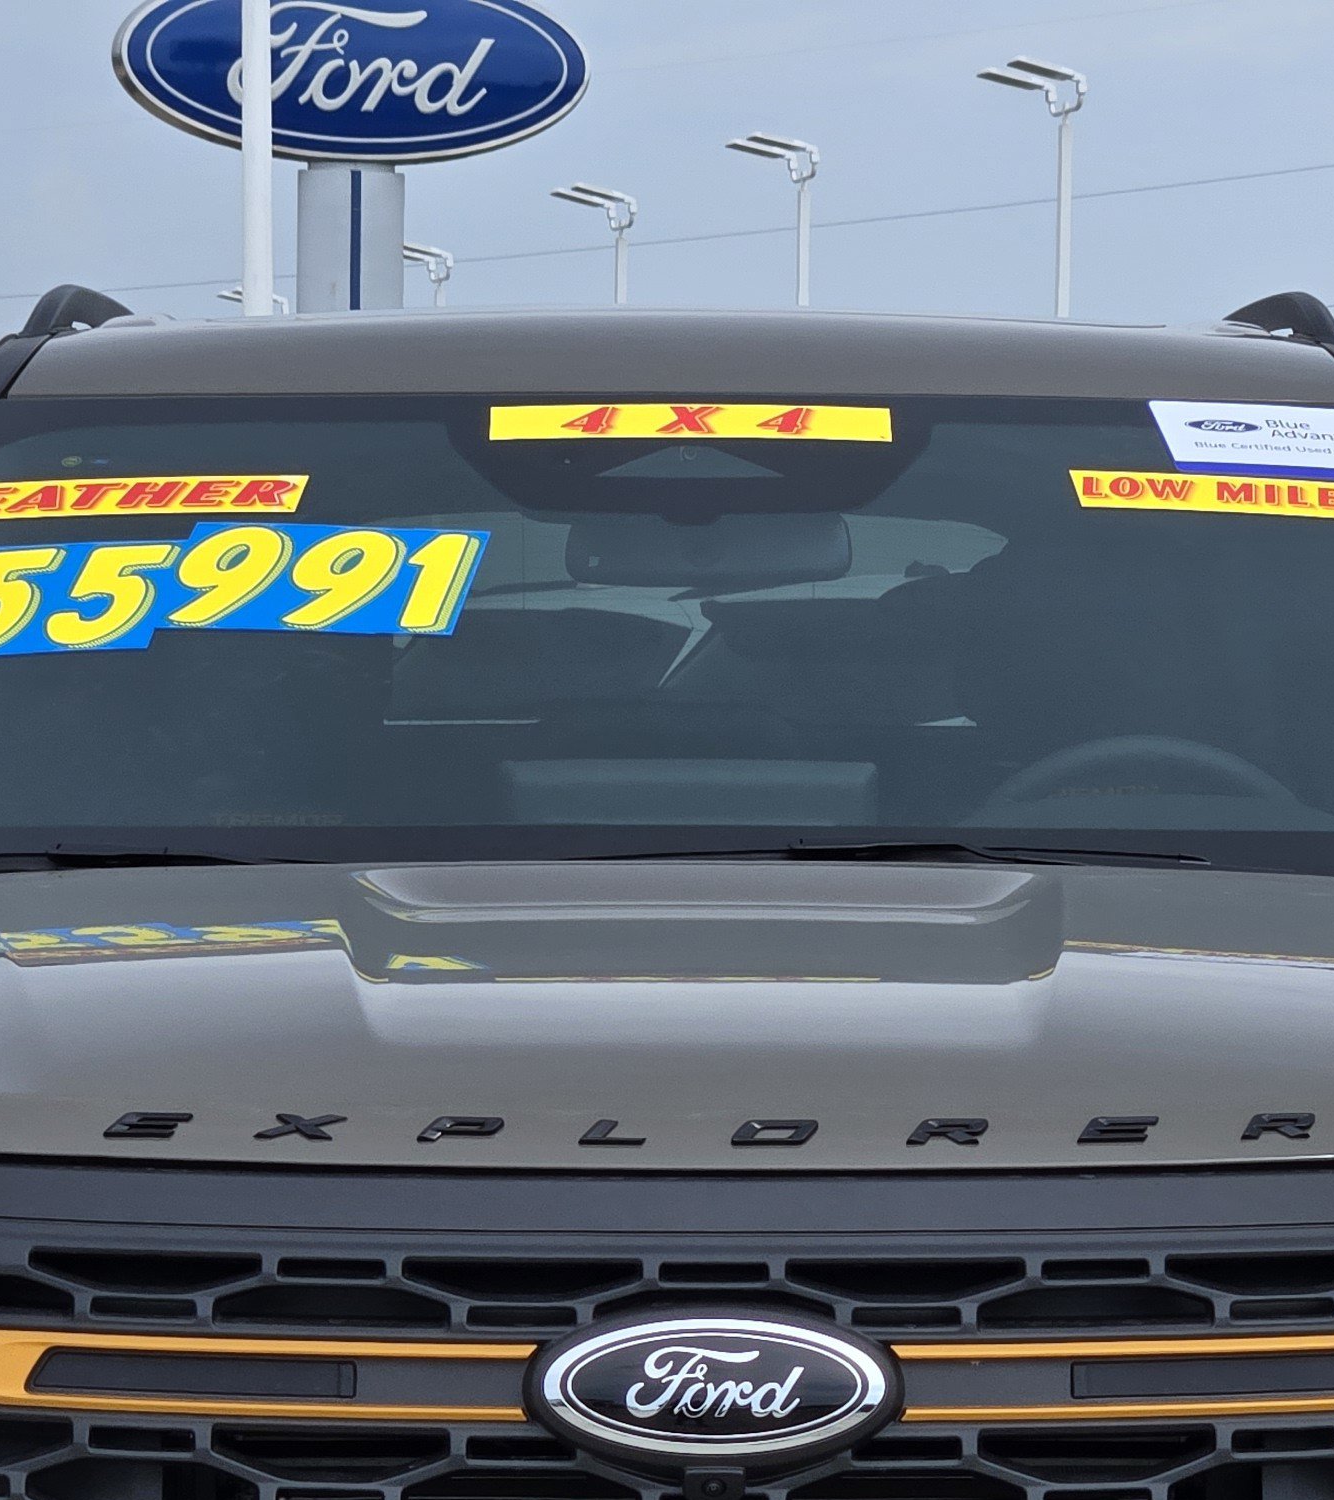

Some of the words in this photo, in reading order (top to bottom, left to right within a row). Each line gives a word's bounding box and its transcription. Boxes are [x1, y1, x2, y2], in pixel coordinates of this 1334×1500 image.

[227, 1, 496, 116] Ford
[560, 406, 619, 434] 4
[656, 406, 724, 434] X
[756, 407, 814, 435] 4
[1200, 420, 1247, 433] Ford
[1266, 419, 1311, 430] Blue
[1194, 441, 1227, 449] Blue
[1231, 442, 1292, 453] Certified
[1296, 446, 1332, 455] Used
[1082, 475, 1194, 501] LOW
[102, 1110, 1317, 1147] EXPLORER
[625, 1344, 804, 1419] Ford
